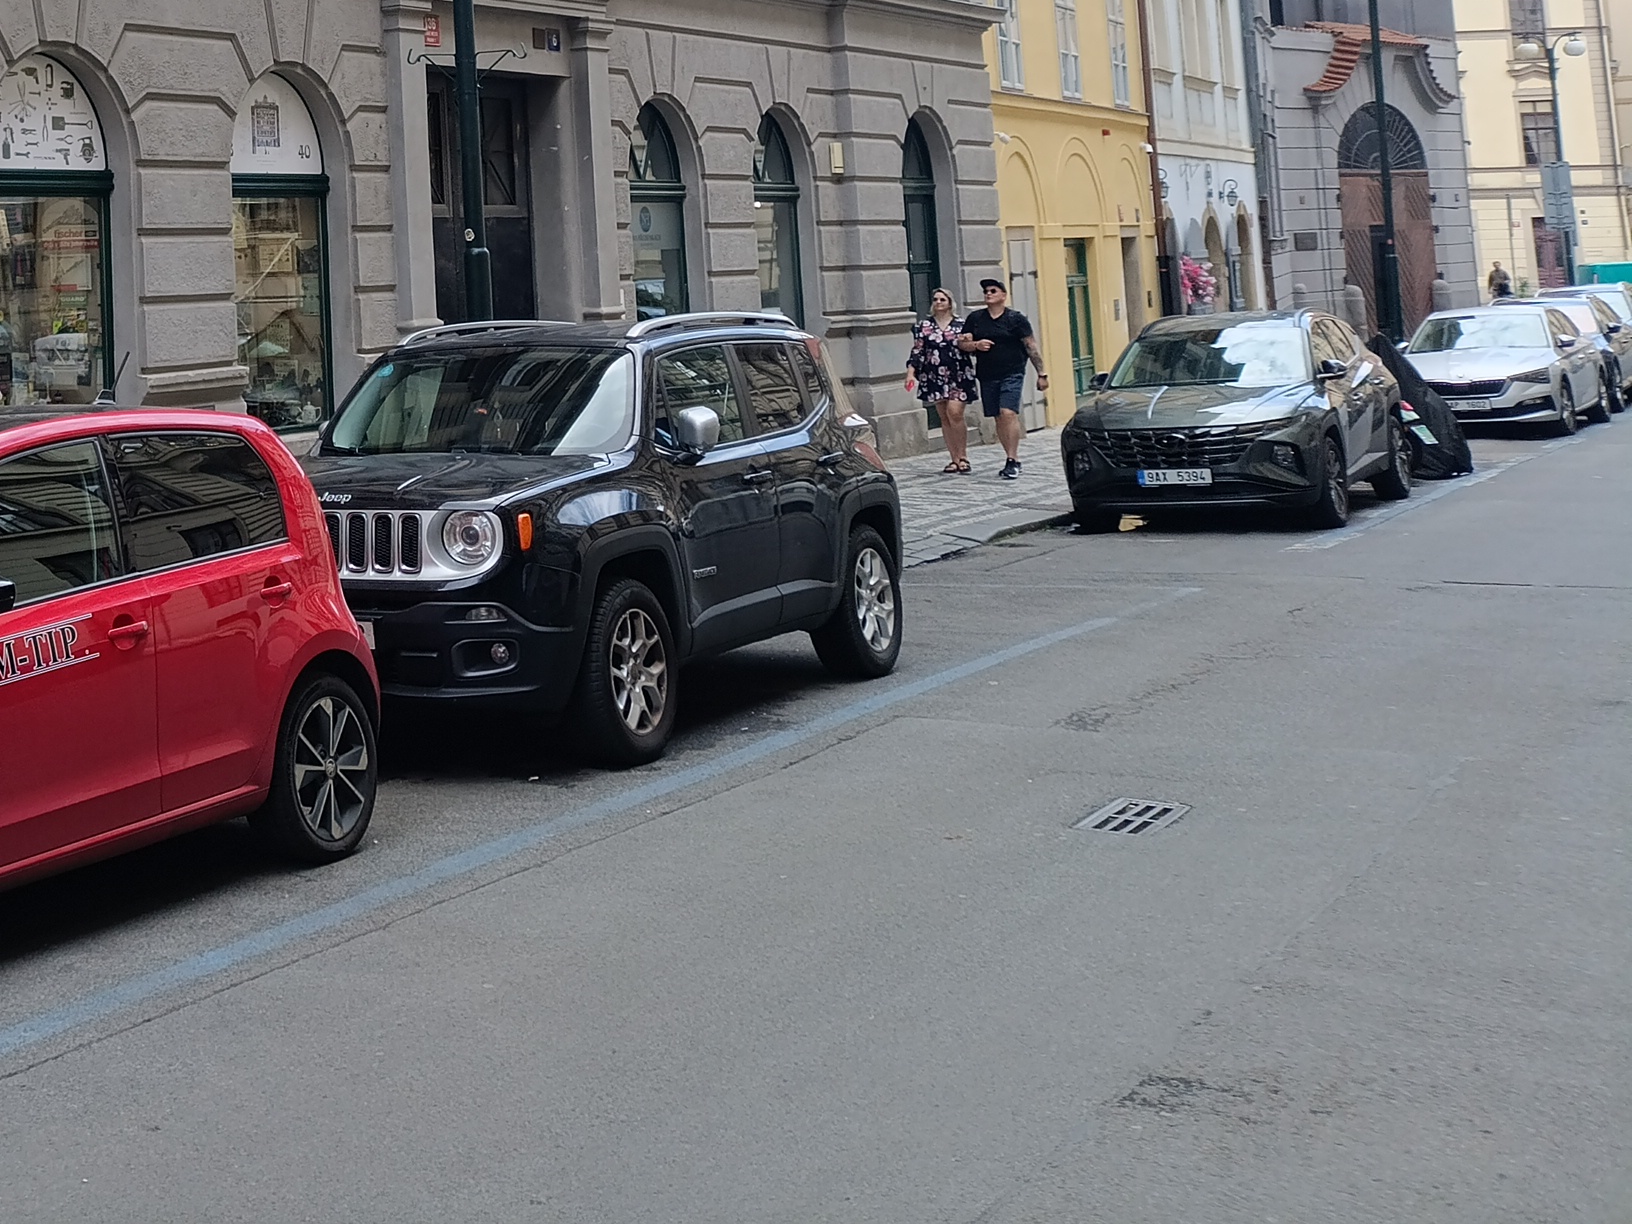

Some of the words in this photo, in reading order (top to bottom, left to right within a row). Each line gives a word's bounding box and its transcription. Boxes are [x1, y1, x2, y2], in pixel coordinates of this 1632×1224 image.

[298, 144, 311, 159] 40
[1147, 471, 1169, 483] 9AX
[1176, 470, 1206, 483] 5394
[318, 491, 352, 505] Jeep
